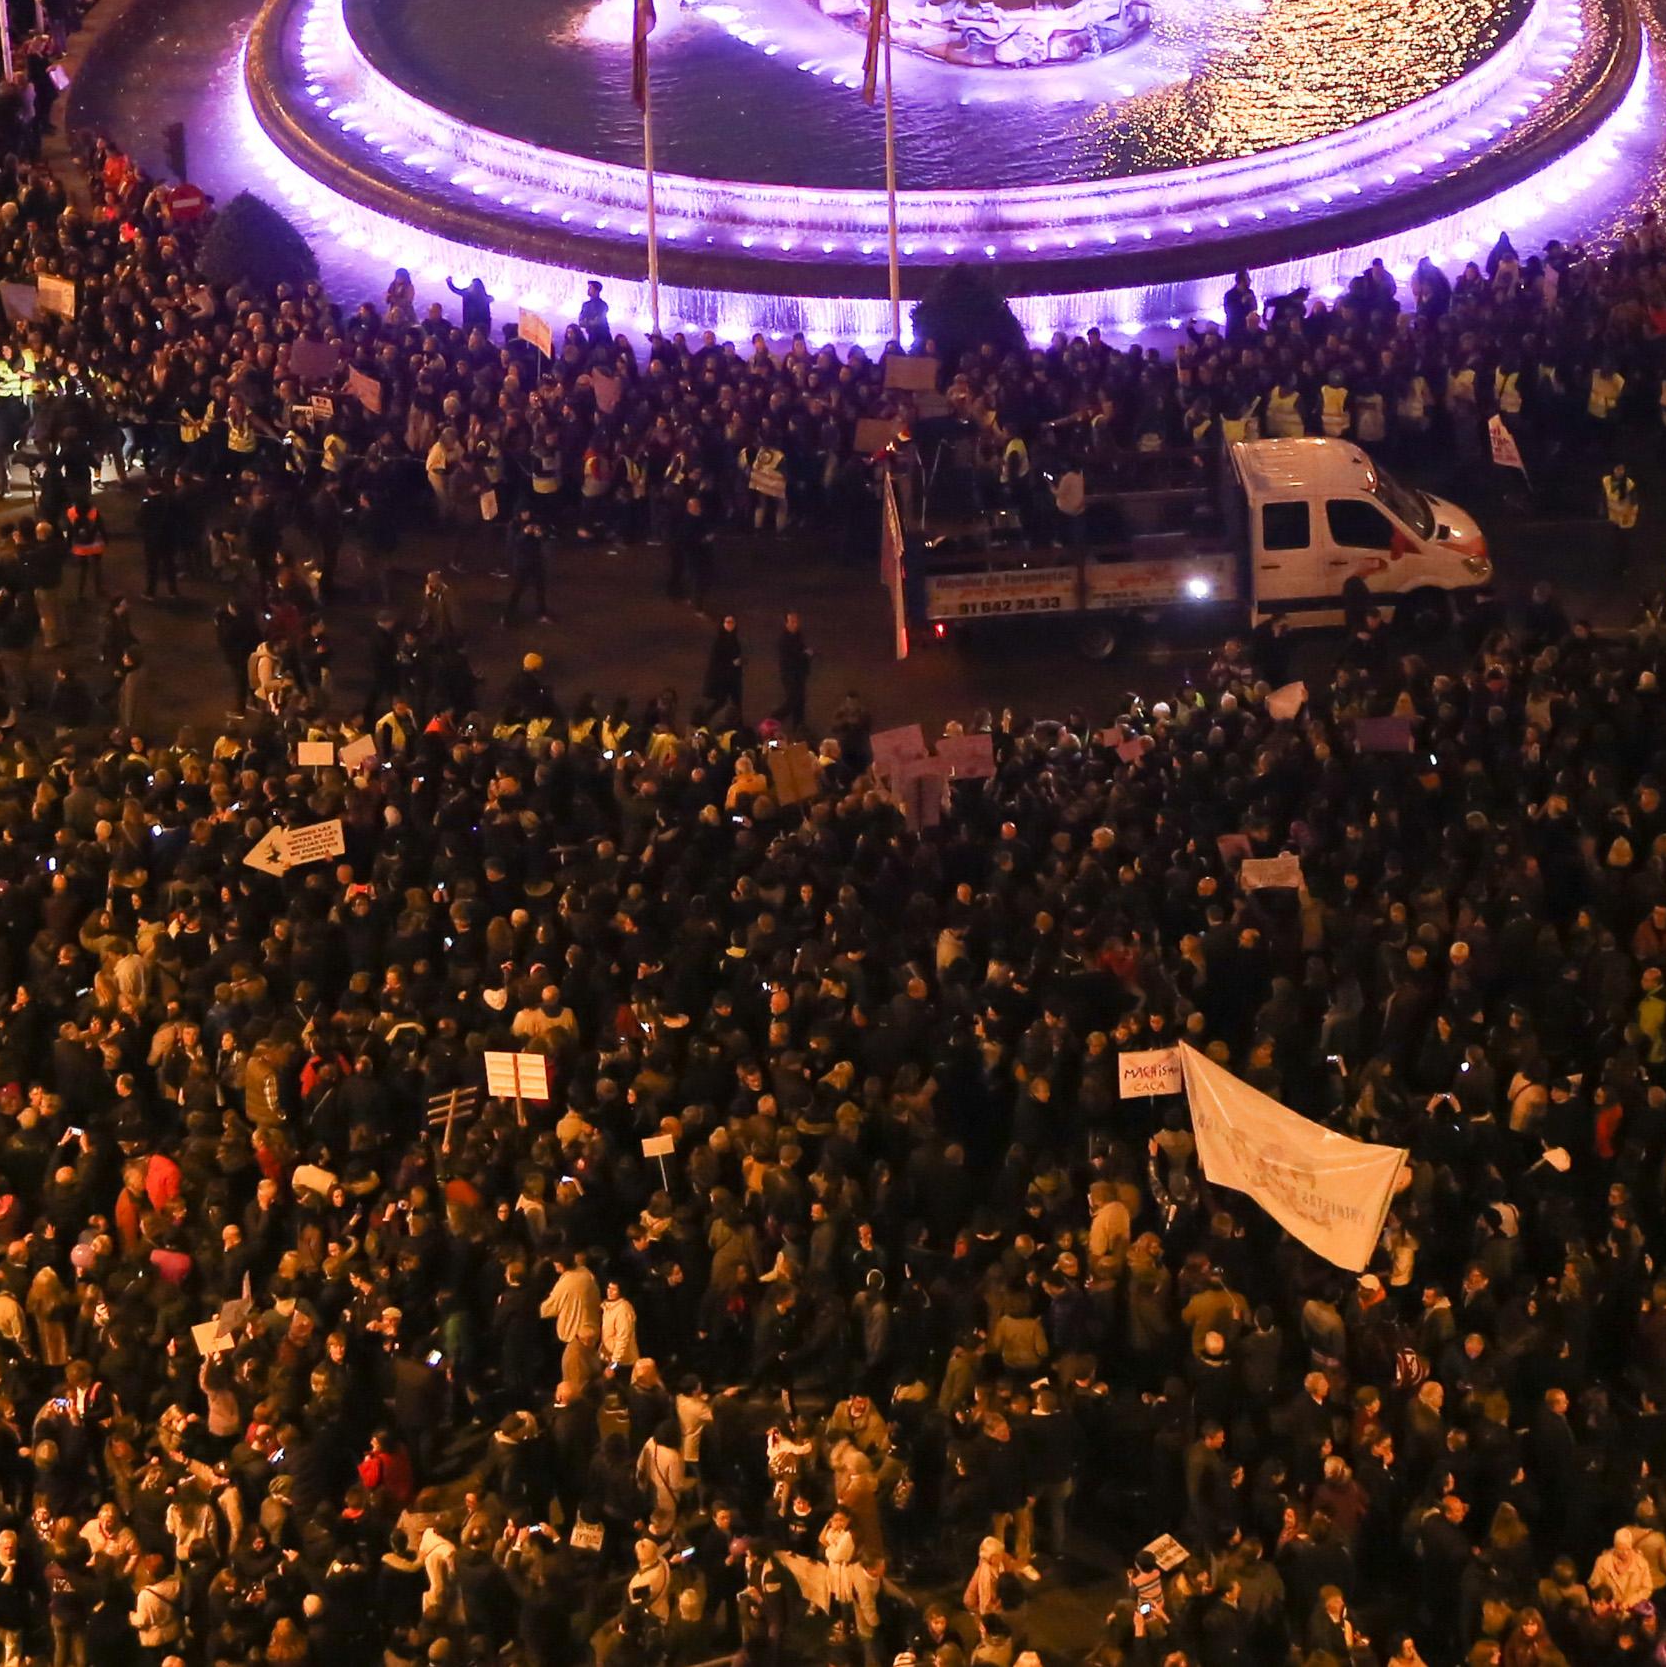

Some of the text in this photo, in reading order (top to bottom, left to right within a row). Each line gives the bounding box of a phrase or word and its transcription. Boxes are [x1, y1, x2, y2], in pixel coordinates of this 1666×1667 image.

[959, 596, 1061, 615] 91 642 24 33
[1133, 1080, 1166, 1092] CACA
